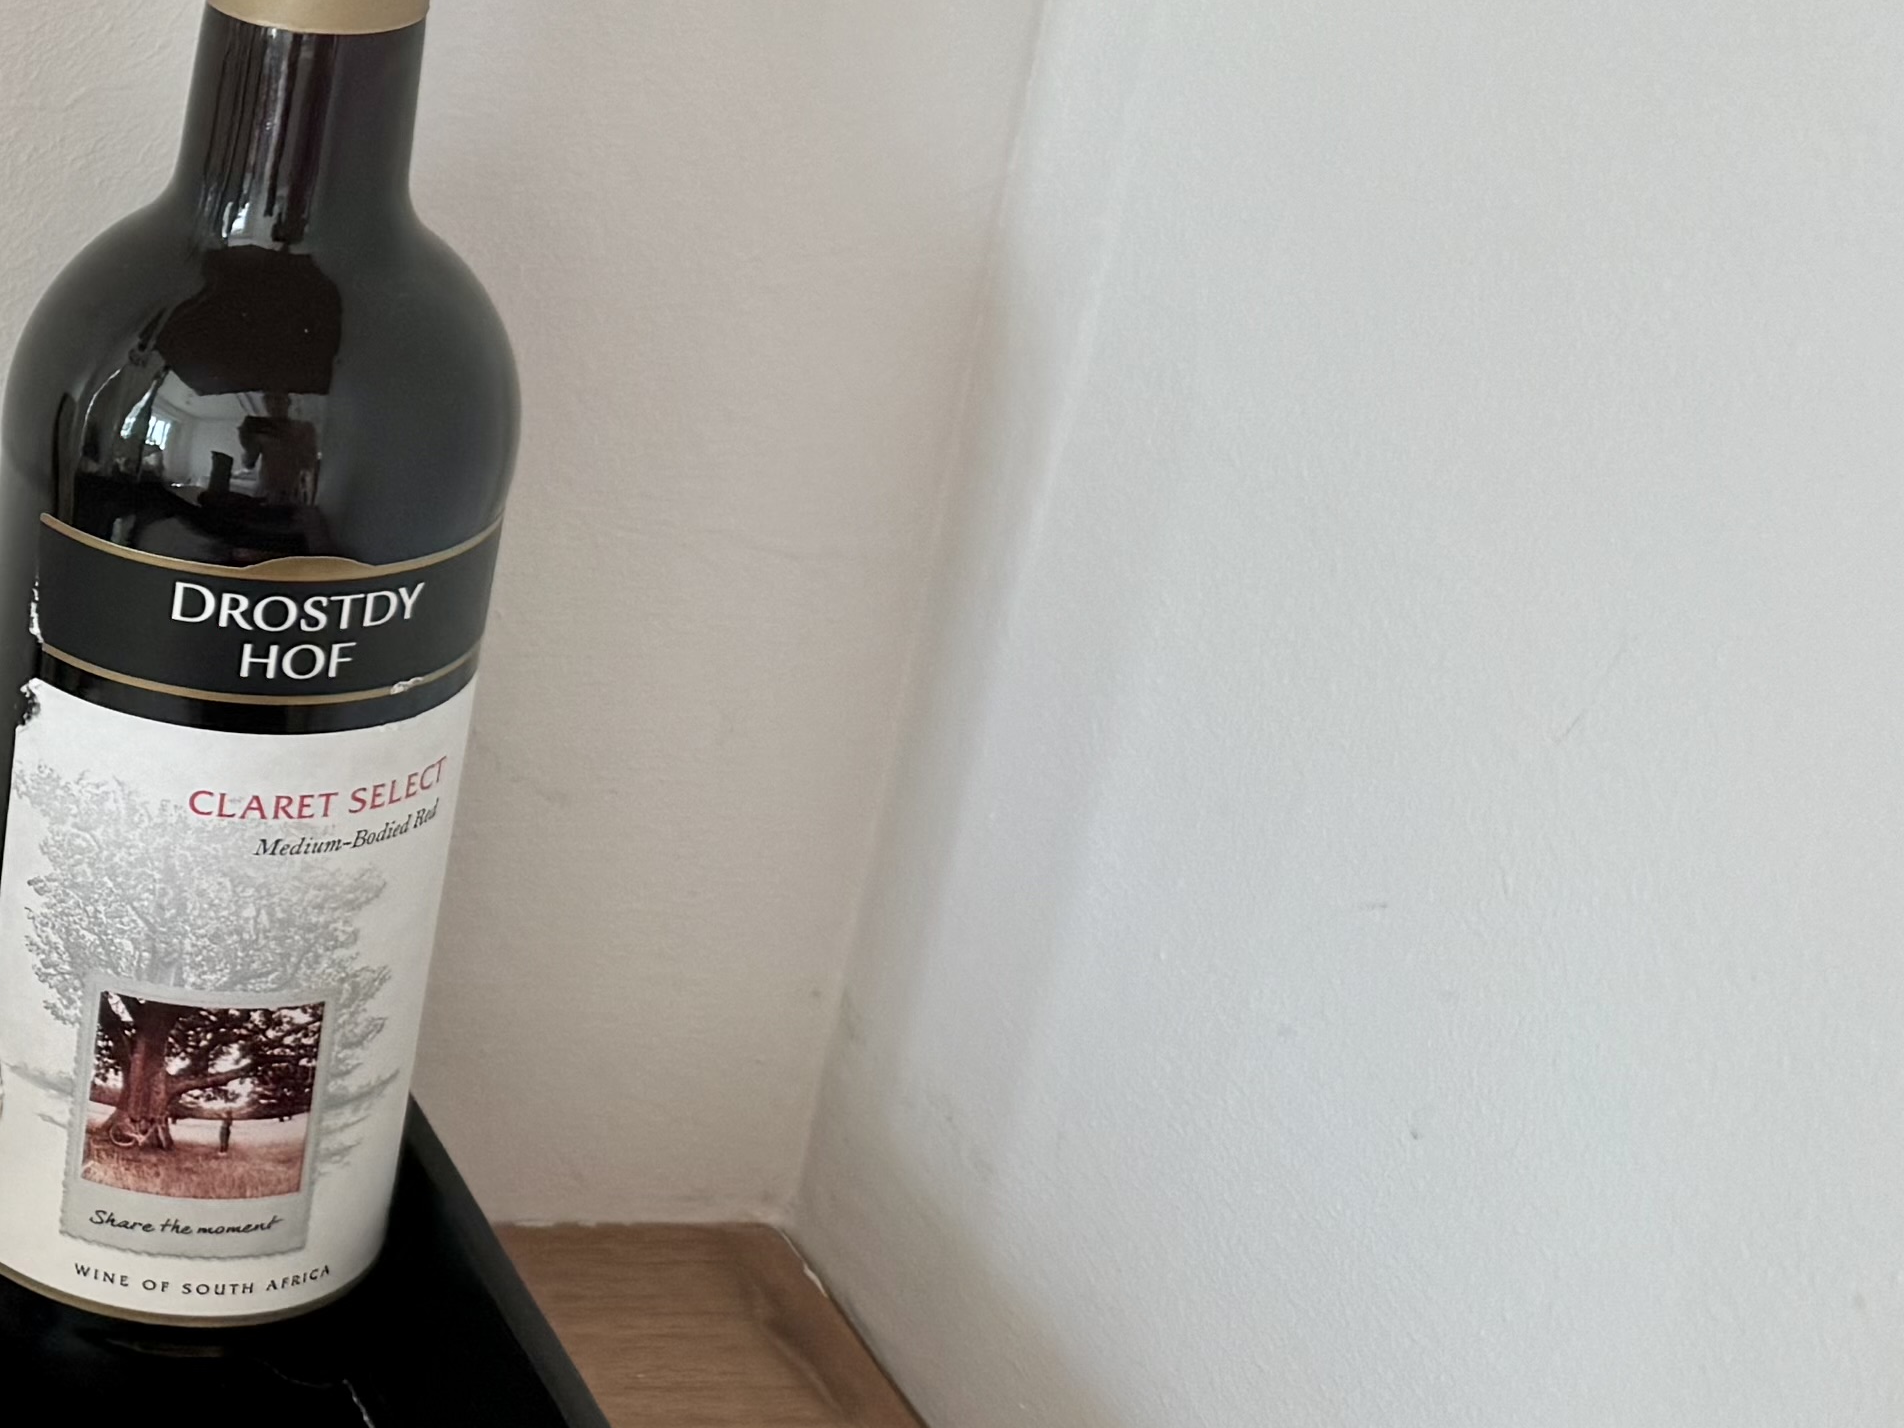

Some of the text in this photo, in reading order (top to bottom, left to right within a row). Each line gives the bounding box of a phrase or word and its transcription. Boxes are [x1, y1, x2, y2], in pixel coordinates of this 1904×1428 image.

[171, 581, 425, 632] DROSTDY
[240, 642, 357, 679] HOF
[188, 756, 447, 820] CLARET SELECT
[254, 798, 439, 856] Medium-Bodied Red
[89, 1210, 284, 1234] Share the moment
[75, 1263, 330, 1295] WINE OF SOUTH AFRICA
